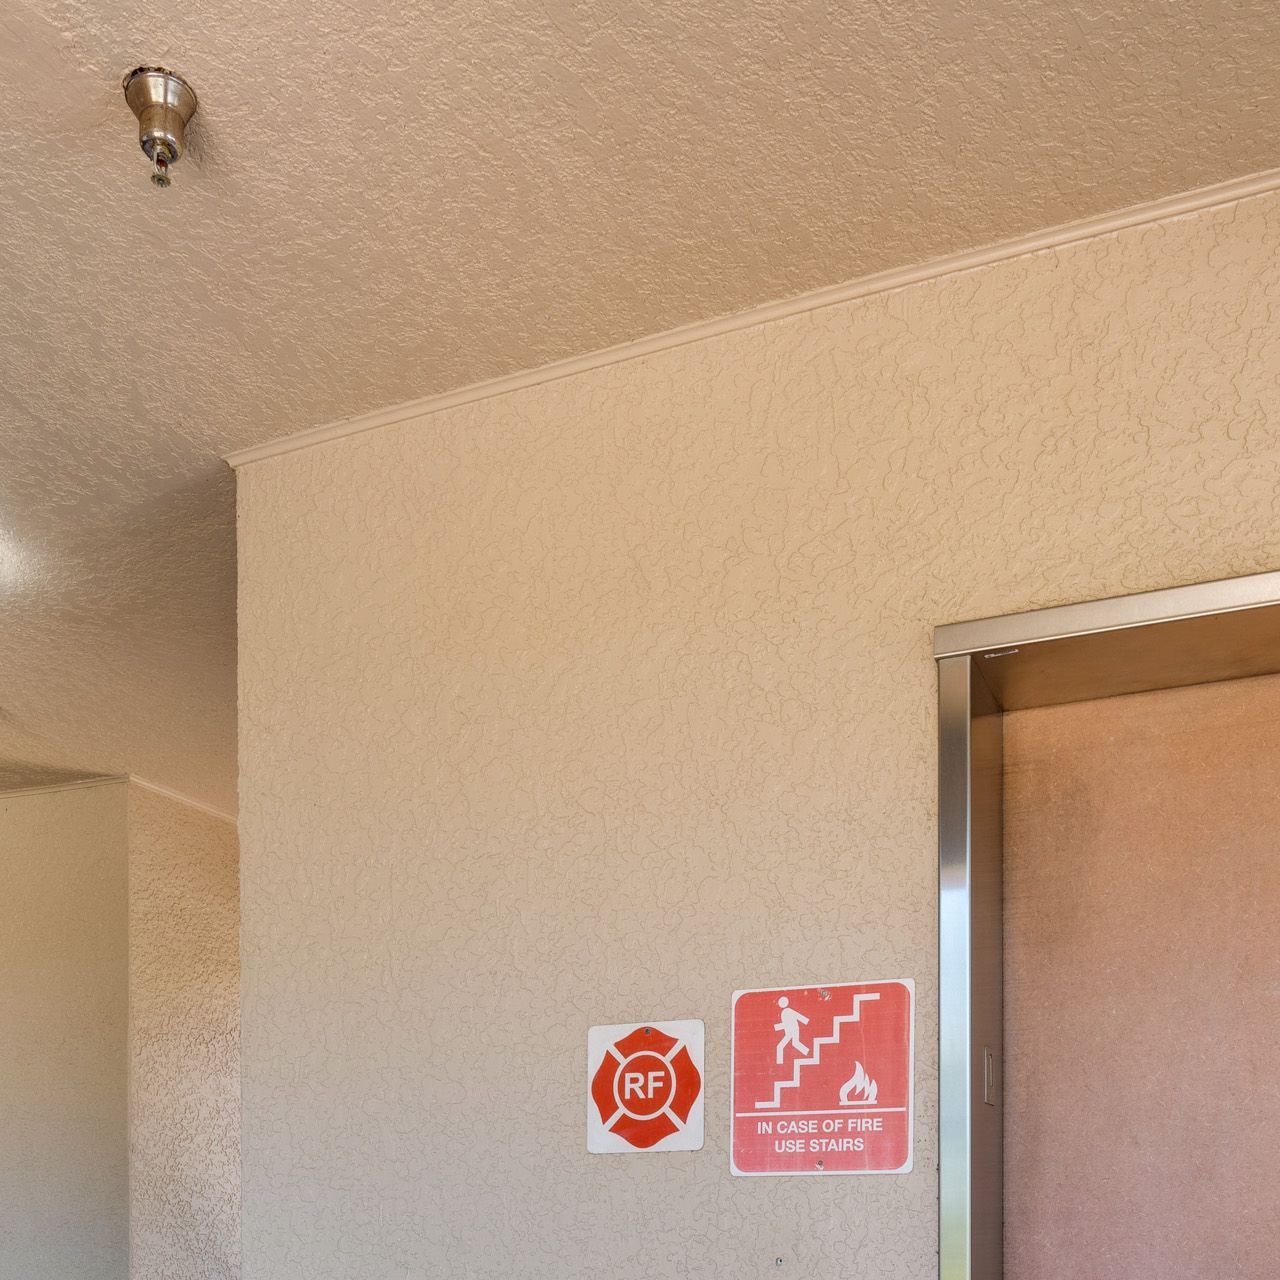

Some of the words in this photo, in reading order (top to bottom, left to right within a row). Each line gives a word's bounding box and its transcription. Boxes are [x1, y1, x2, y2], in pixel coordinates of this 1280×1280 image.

[625, 1071, 664, 1099] RF
[758, 1122, 772, 1134] IN
[777, 1120, 818, 1133] CASE
[822, 1120, 843, 1132] OF
[848, 1118, 883, 1131] FIRE
[775, 1140, 805, 1152] USE
[810, 1138, 864, 1152] STAIRS
